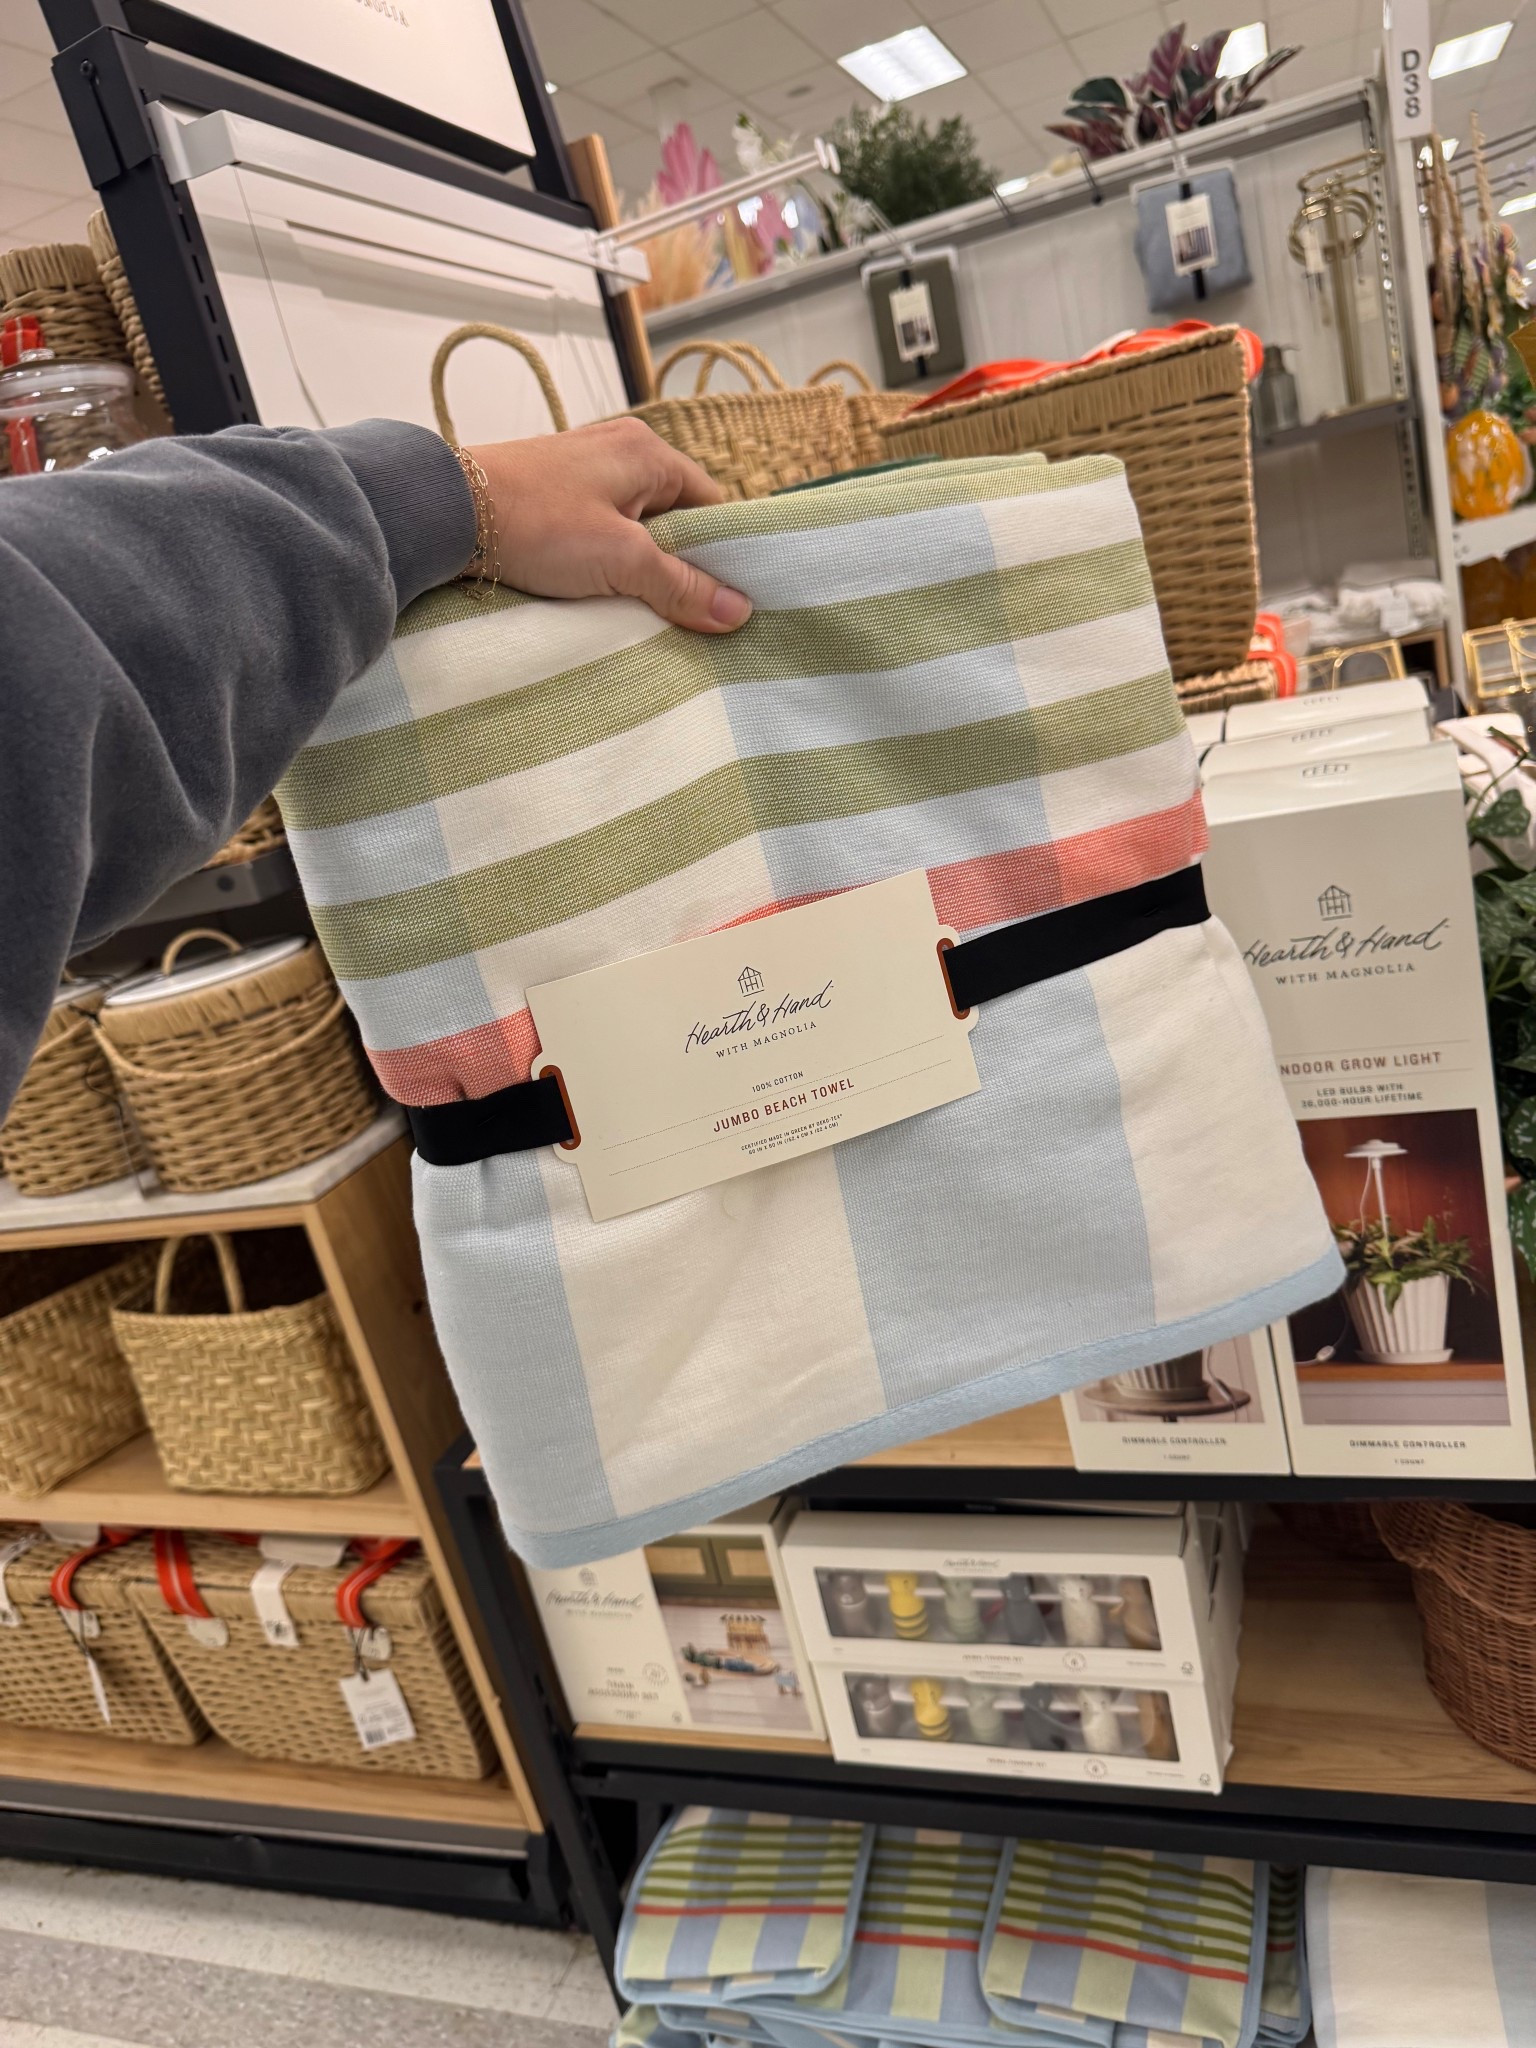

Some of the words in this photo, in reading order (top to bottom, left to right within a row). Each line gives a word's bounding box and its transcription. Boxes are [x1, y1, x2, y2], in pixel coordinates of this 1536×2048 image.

[1401, 49, 1421, 119] D38
[1242, 927, 1338, 967] Hearth
[1336, 931, 1354, 959] &
[1355, 918, 1449, 957] Hand
[1276, 972, 1318, 985] WITH
[1326, 963, 1415, 981] MAGNOLIA
[685, 1001, 757, 1053] Hearth
[756, 1003, 770, 1027] &
[771, 980, 833, 1023] Hand
[716, 1042, 748, 1058] WITH
[753, 1021, 817, 1047] MAGNOLIA
[1279, 1060, 1335, 1075] NDOOR
[1340, 1056, 1387, 1071] GROW
[1393, 1051, 1442, 1066] LIGHT
[752, 1081, 772, 1093] 100%
[773, 1071, 804, 1086] COTTON
[1339, 1085, 1373, 1095] BULBS
[1376, 1082, 1404, 1092] WITH
[713, 1108, 760, 1133] JUMBO
[764, 1093, 807, 1116] BEACH
[811, 1078, 855, 1100] TOWEL
[1374, 1091, 1423, 1103] LIFETIME
[768, 1133, 783, 1142] MADE
